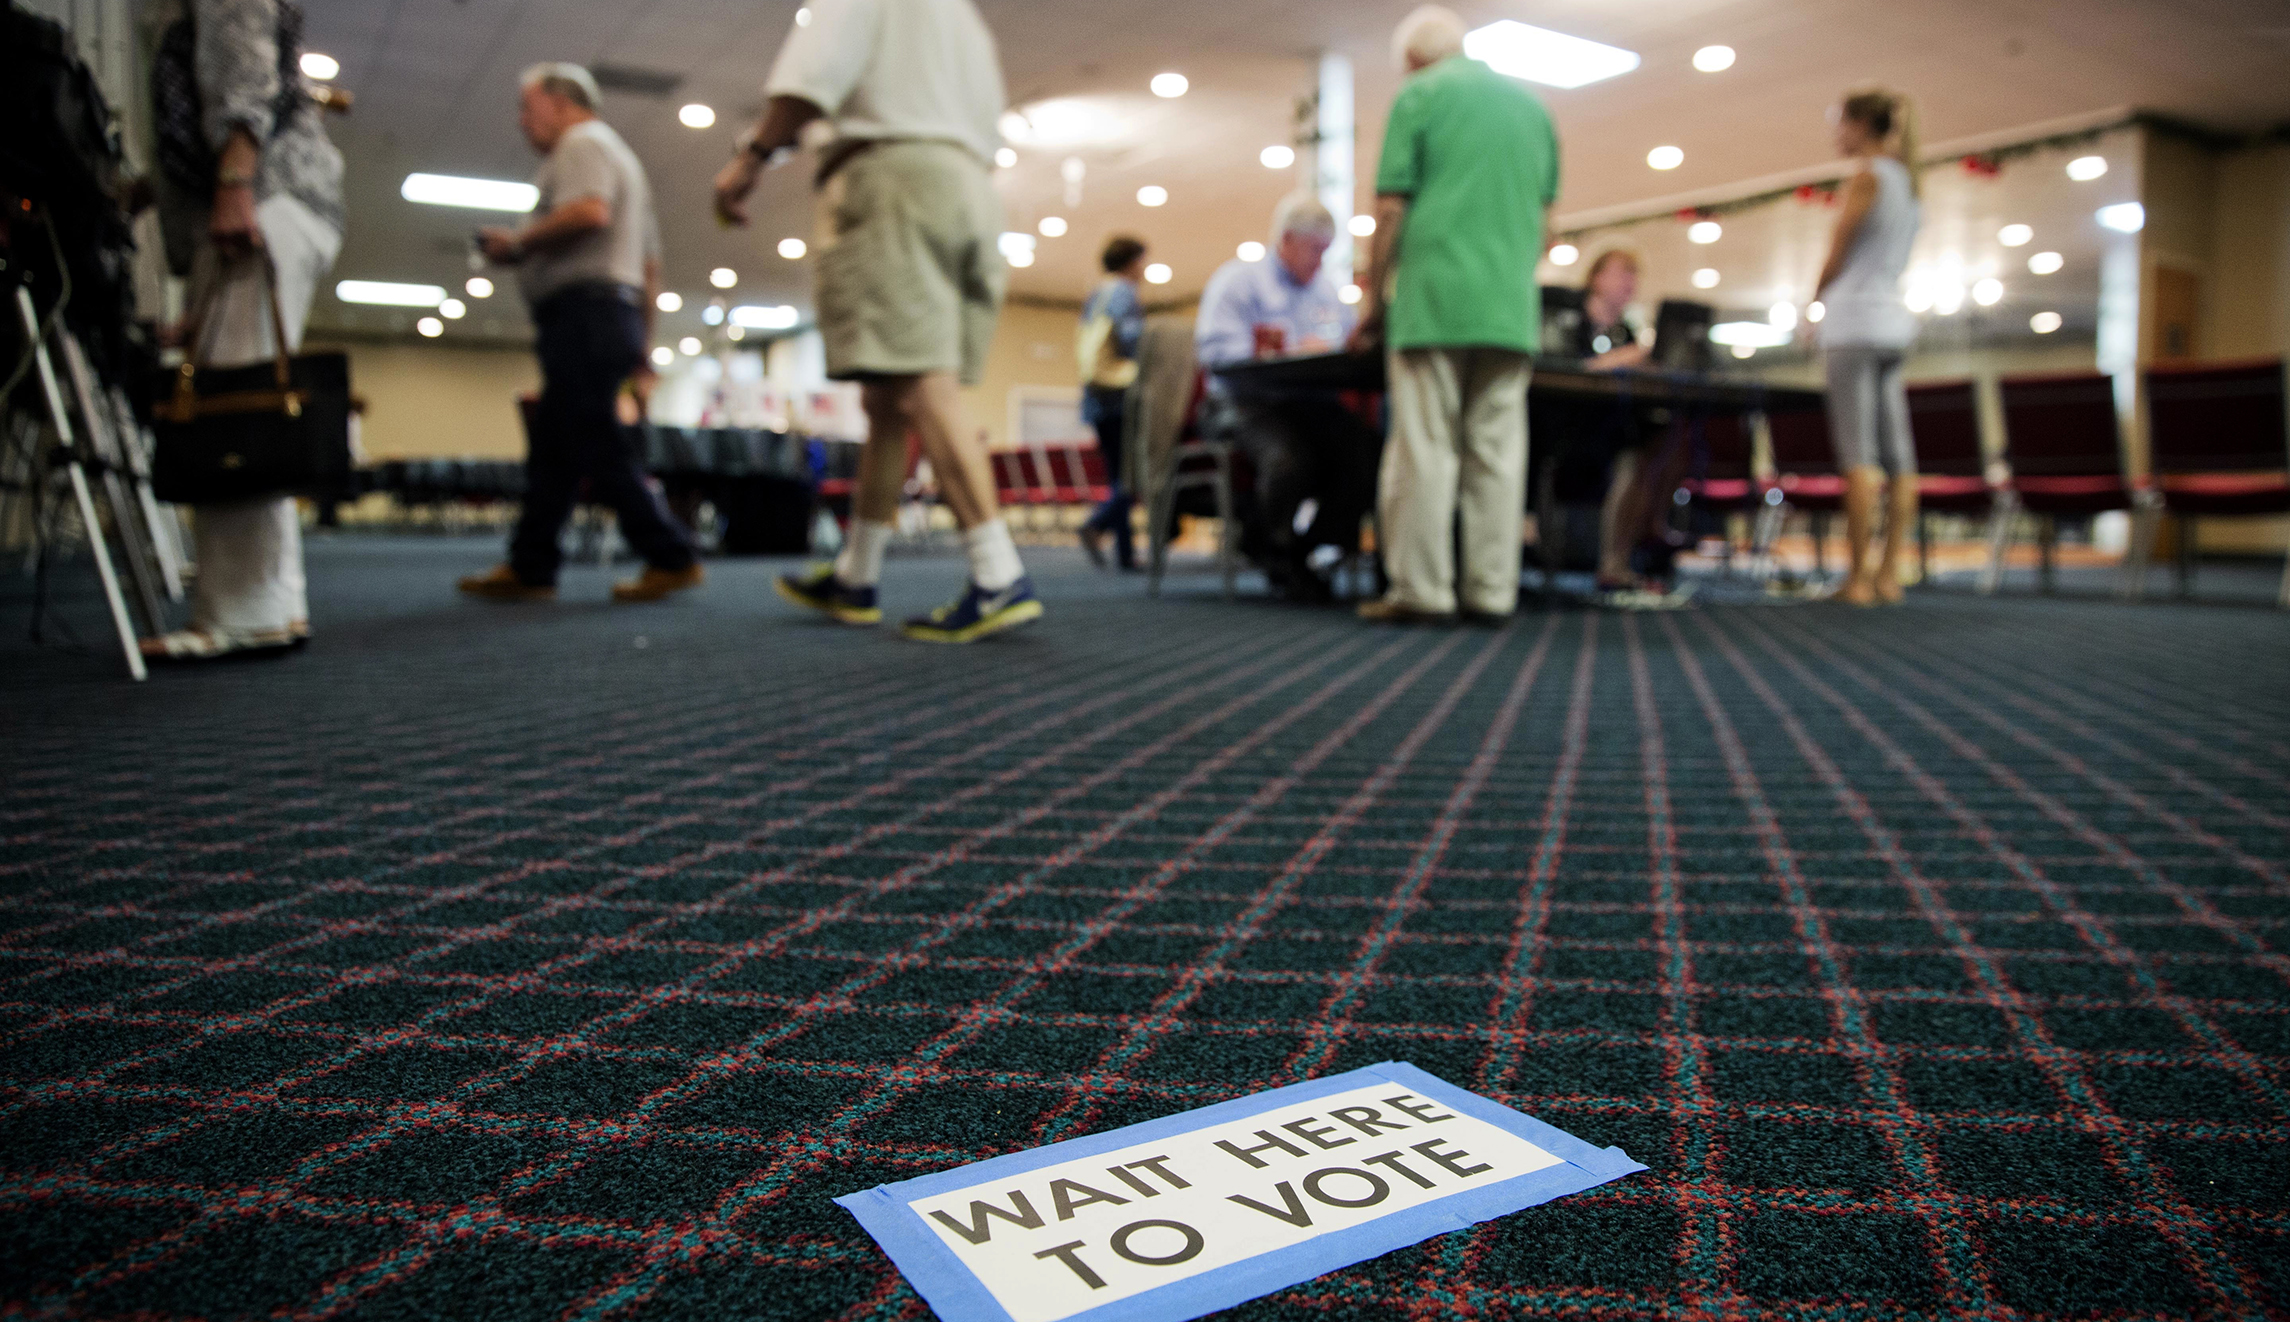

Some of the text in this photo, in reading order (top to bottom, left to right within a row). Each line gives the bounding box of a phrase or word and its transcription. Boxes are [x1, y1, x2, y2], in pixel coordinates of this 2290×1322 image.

[928, 1094, 1457, 1245] WAIT HERE
[1033, 1138, 1494, 1290] TO VOTE
